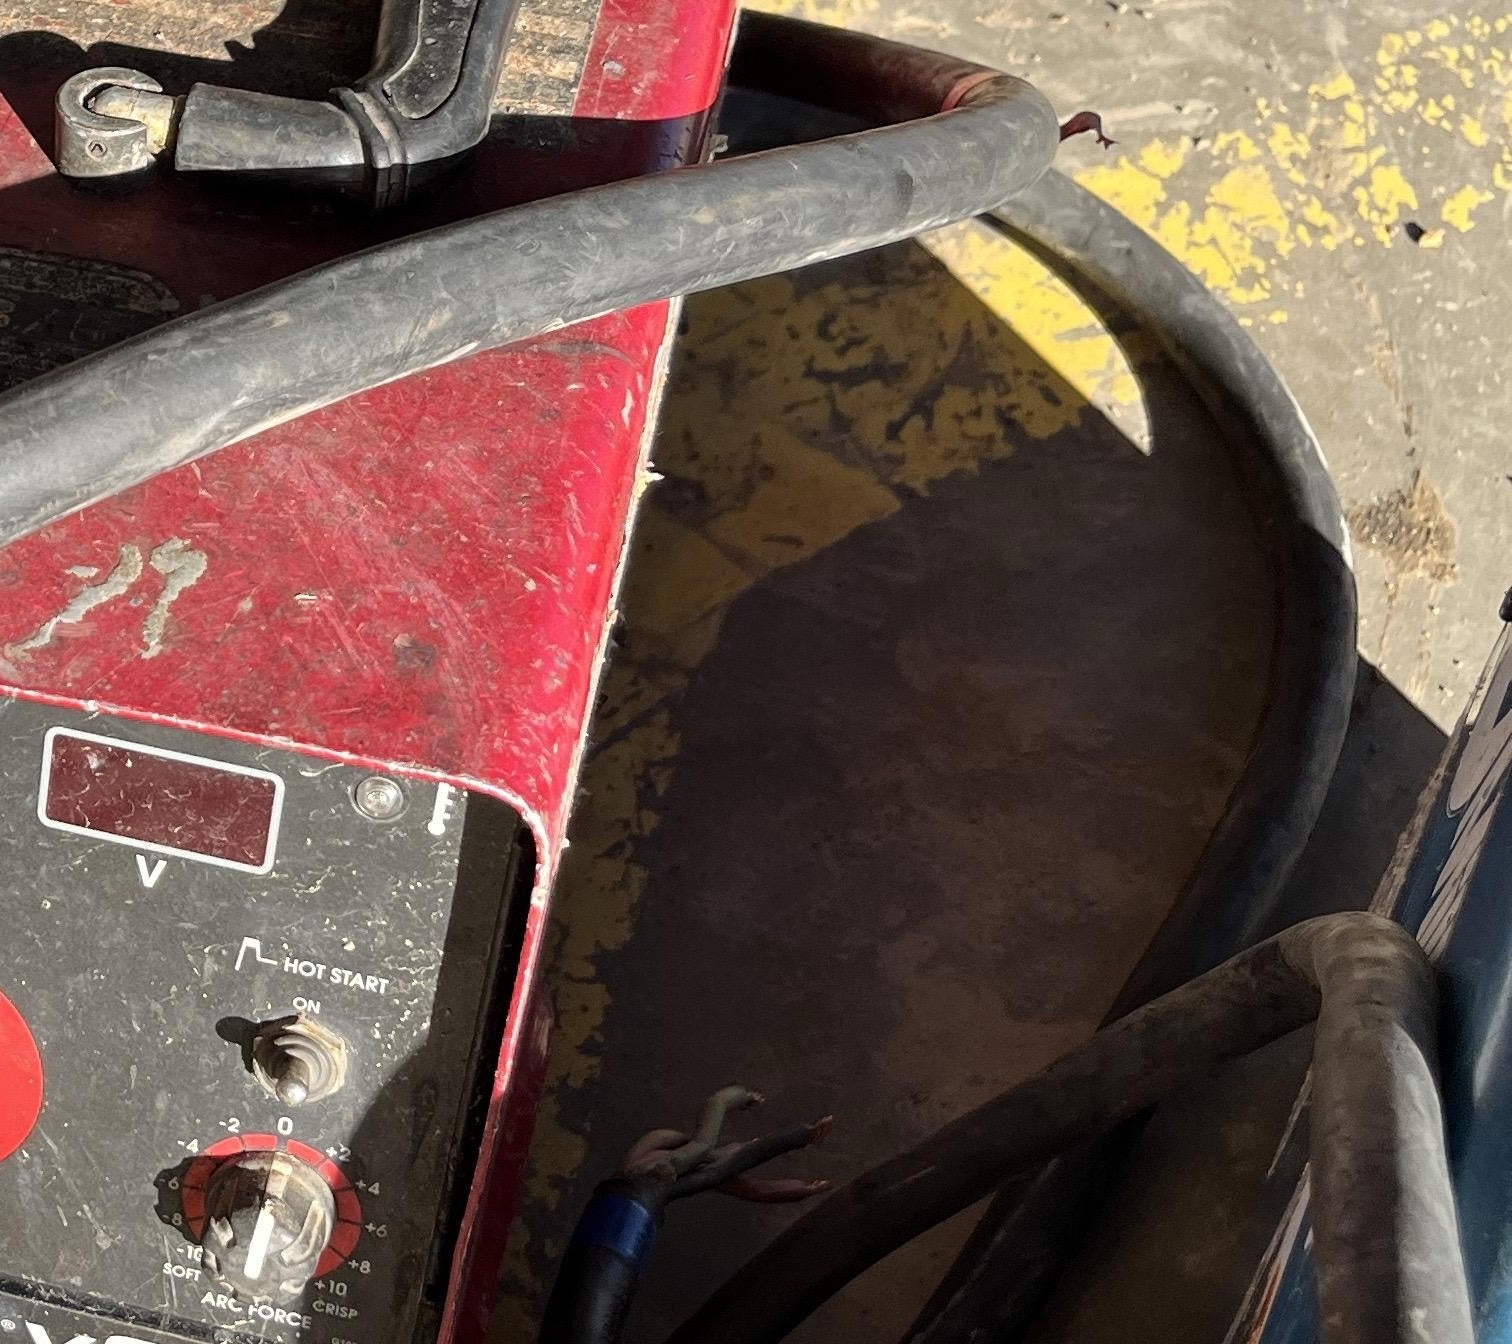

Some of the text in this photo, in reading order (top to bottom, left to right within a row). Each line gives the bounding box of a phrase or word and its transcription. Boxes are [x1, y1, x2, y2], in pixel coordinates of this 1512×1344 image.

[135, 853, 168, 889] V
[283, 956, 389, 995] HOT START
[291, 996, 321, 1015] ON
[218, 1116, 241, 1133] -2
[276, 1116, 294, 1136] 0
[177, 1137, 199, 1154] -4
[355, 1178, 381, 1196] +4
[364, 1222, 388, 1238] +6
[162, 1262, 202, 1282] SOFT
[348, 1258, 372, 1274] +8
[313, 1278, 348, 1297] +10
[200, 1291, 313, 1330] ARC FORCE
[311, 1297, 359, 1320] CRISP
